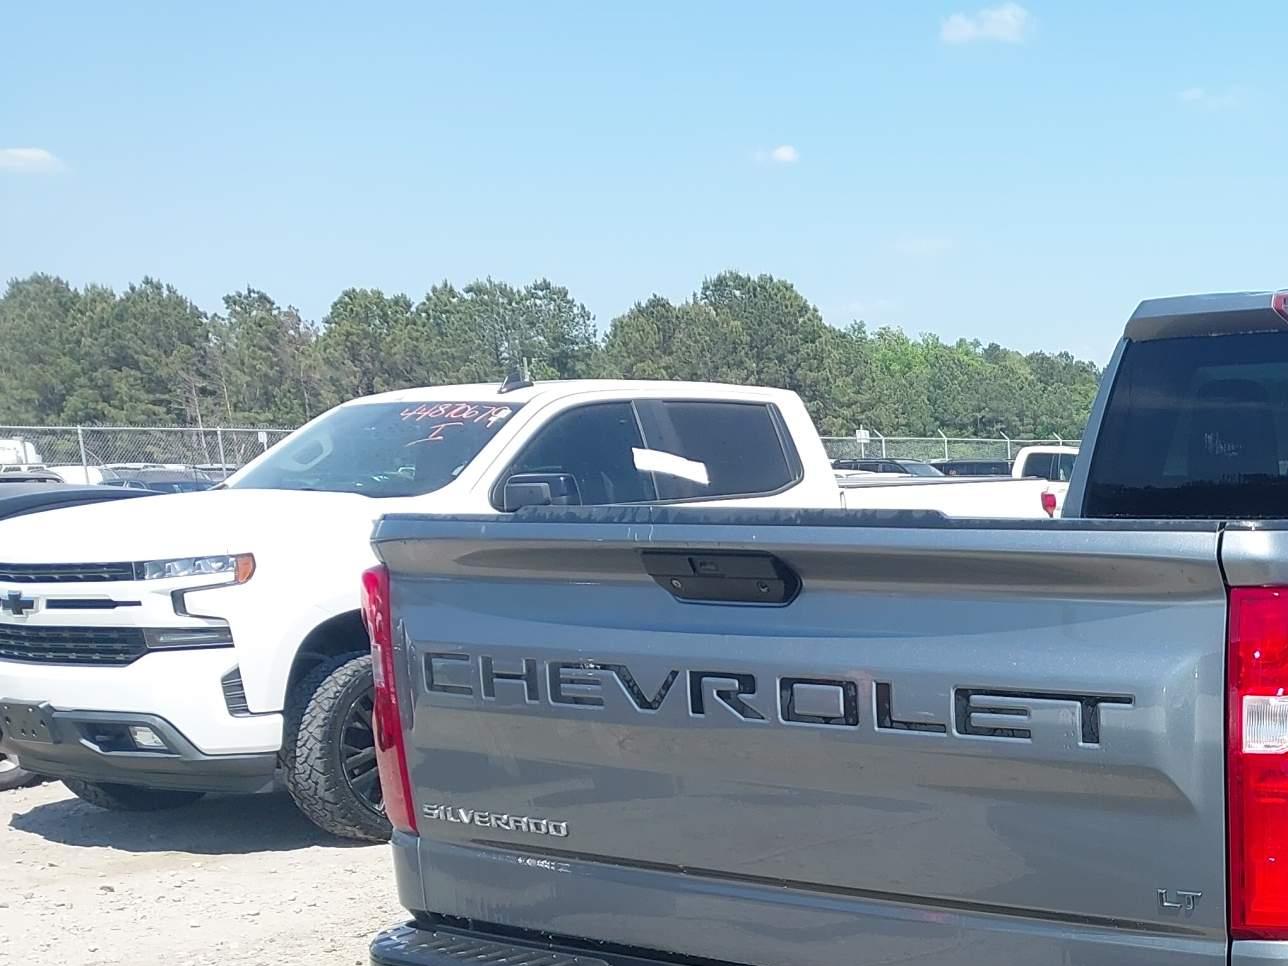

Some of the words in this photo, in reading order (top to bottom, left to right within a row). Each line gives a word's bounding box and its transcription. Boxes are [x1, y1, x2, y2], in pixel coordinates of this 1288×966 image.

[423, 651, 1135, 749] CHEVROLET
[423, 803, 570, 838] SILVERADO
[1157, 888, 1202, 911] LT
